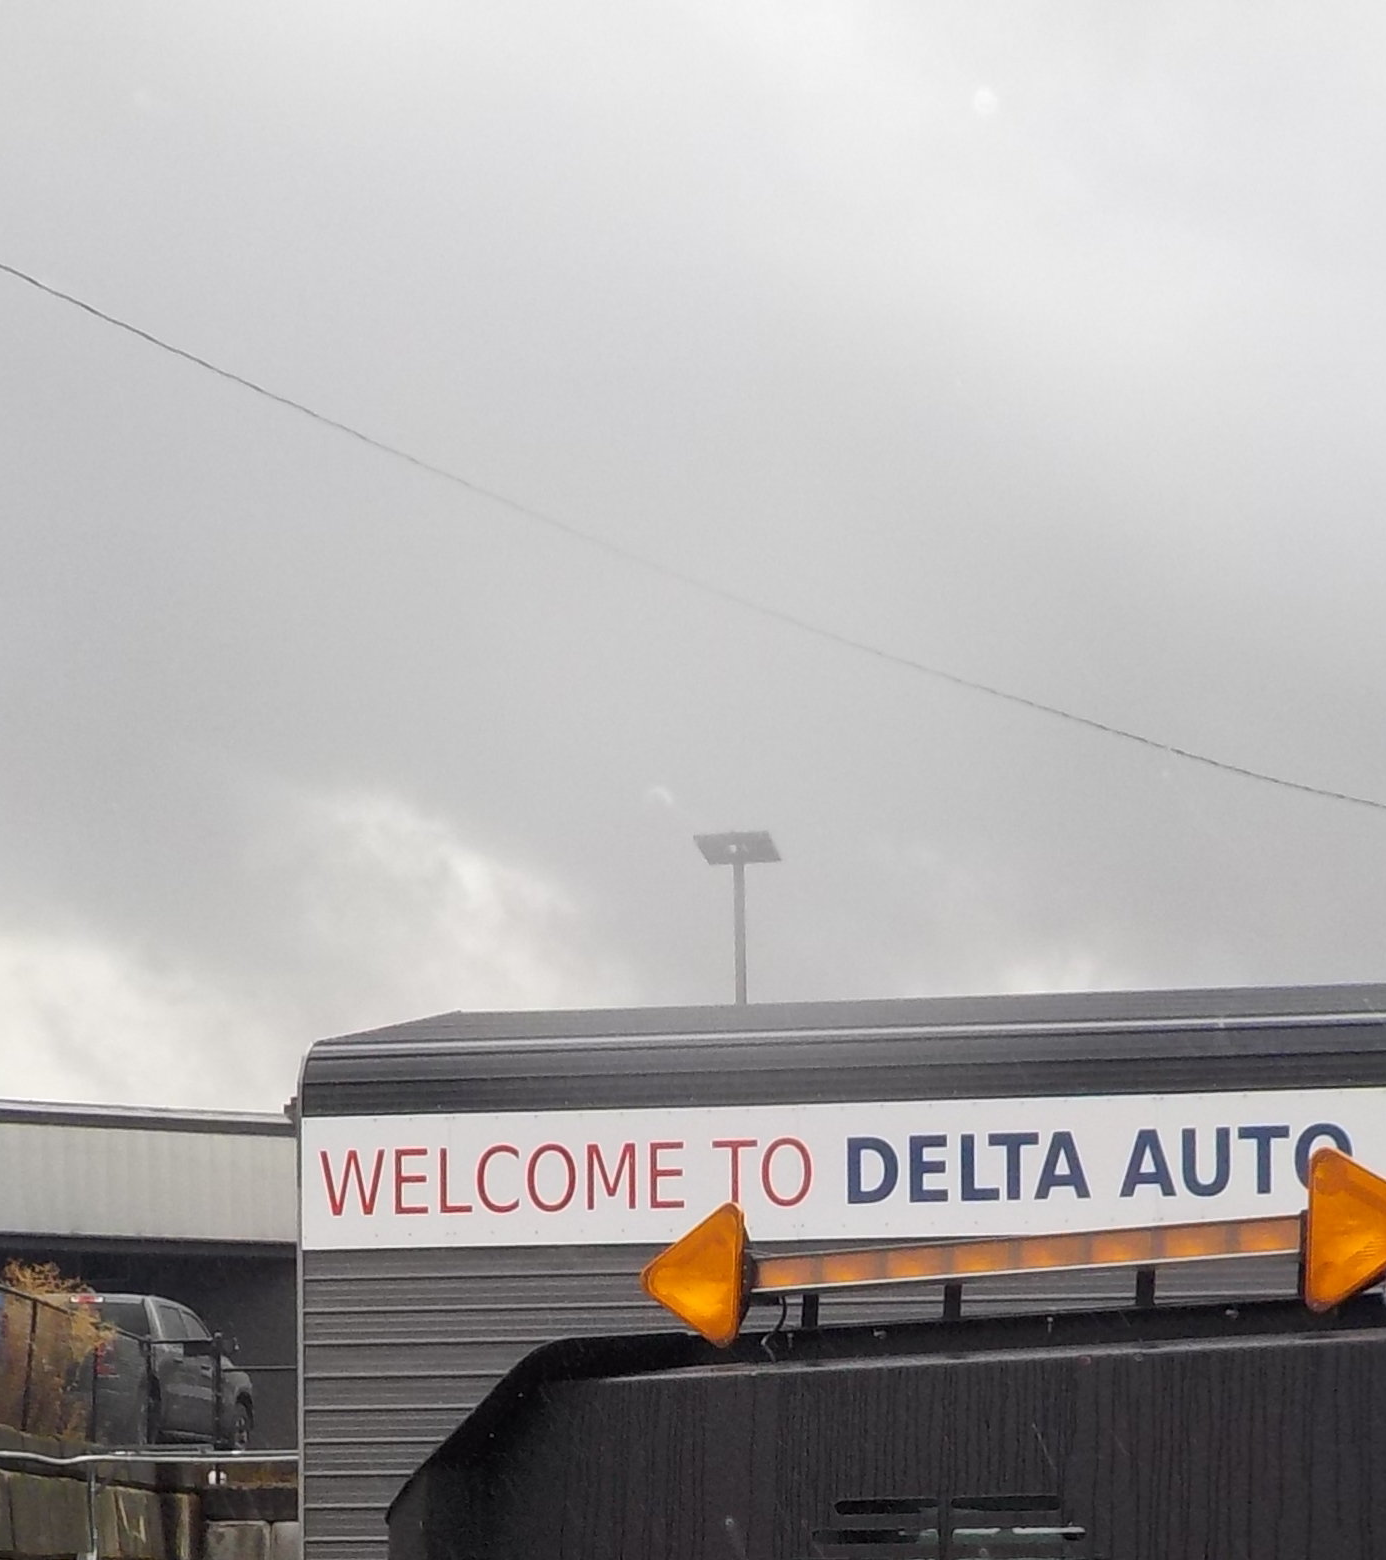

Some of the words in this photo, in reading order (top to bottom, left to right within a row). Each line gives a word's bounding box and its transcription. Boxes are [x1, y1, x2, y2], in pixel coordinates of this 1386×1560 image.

[319, 1141, 685, 1217] WELCOME
[711, 1136, 813, 1207] TO
[846, 1130, 1092, 1204] DELTA
[1119, 1122, 1354, 1198] AUTO
